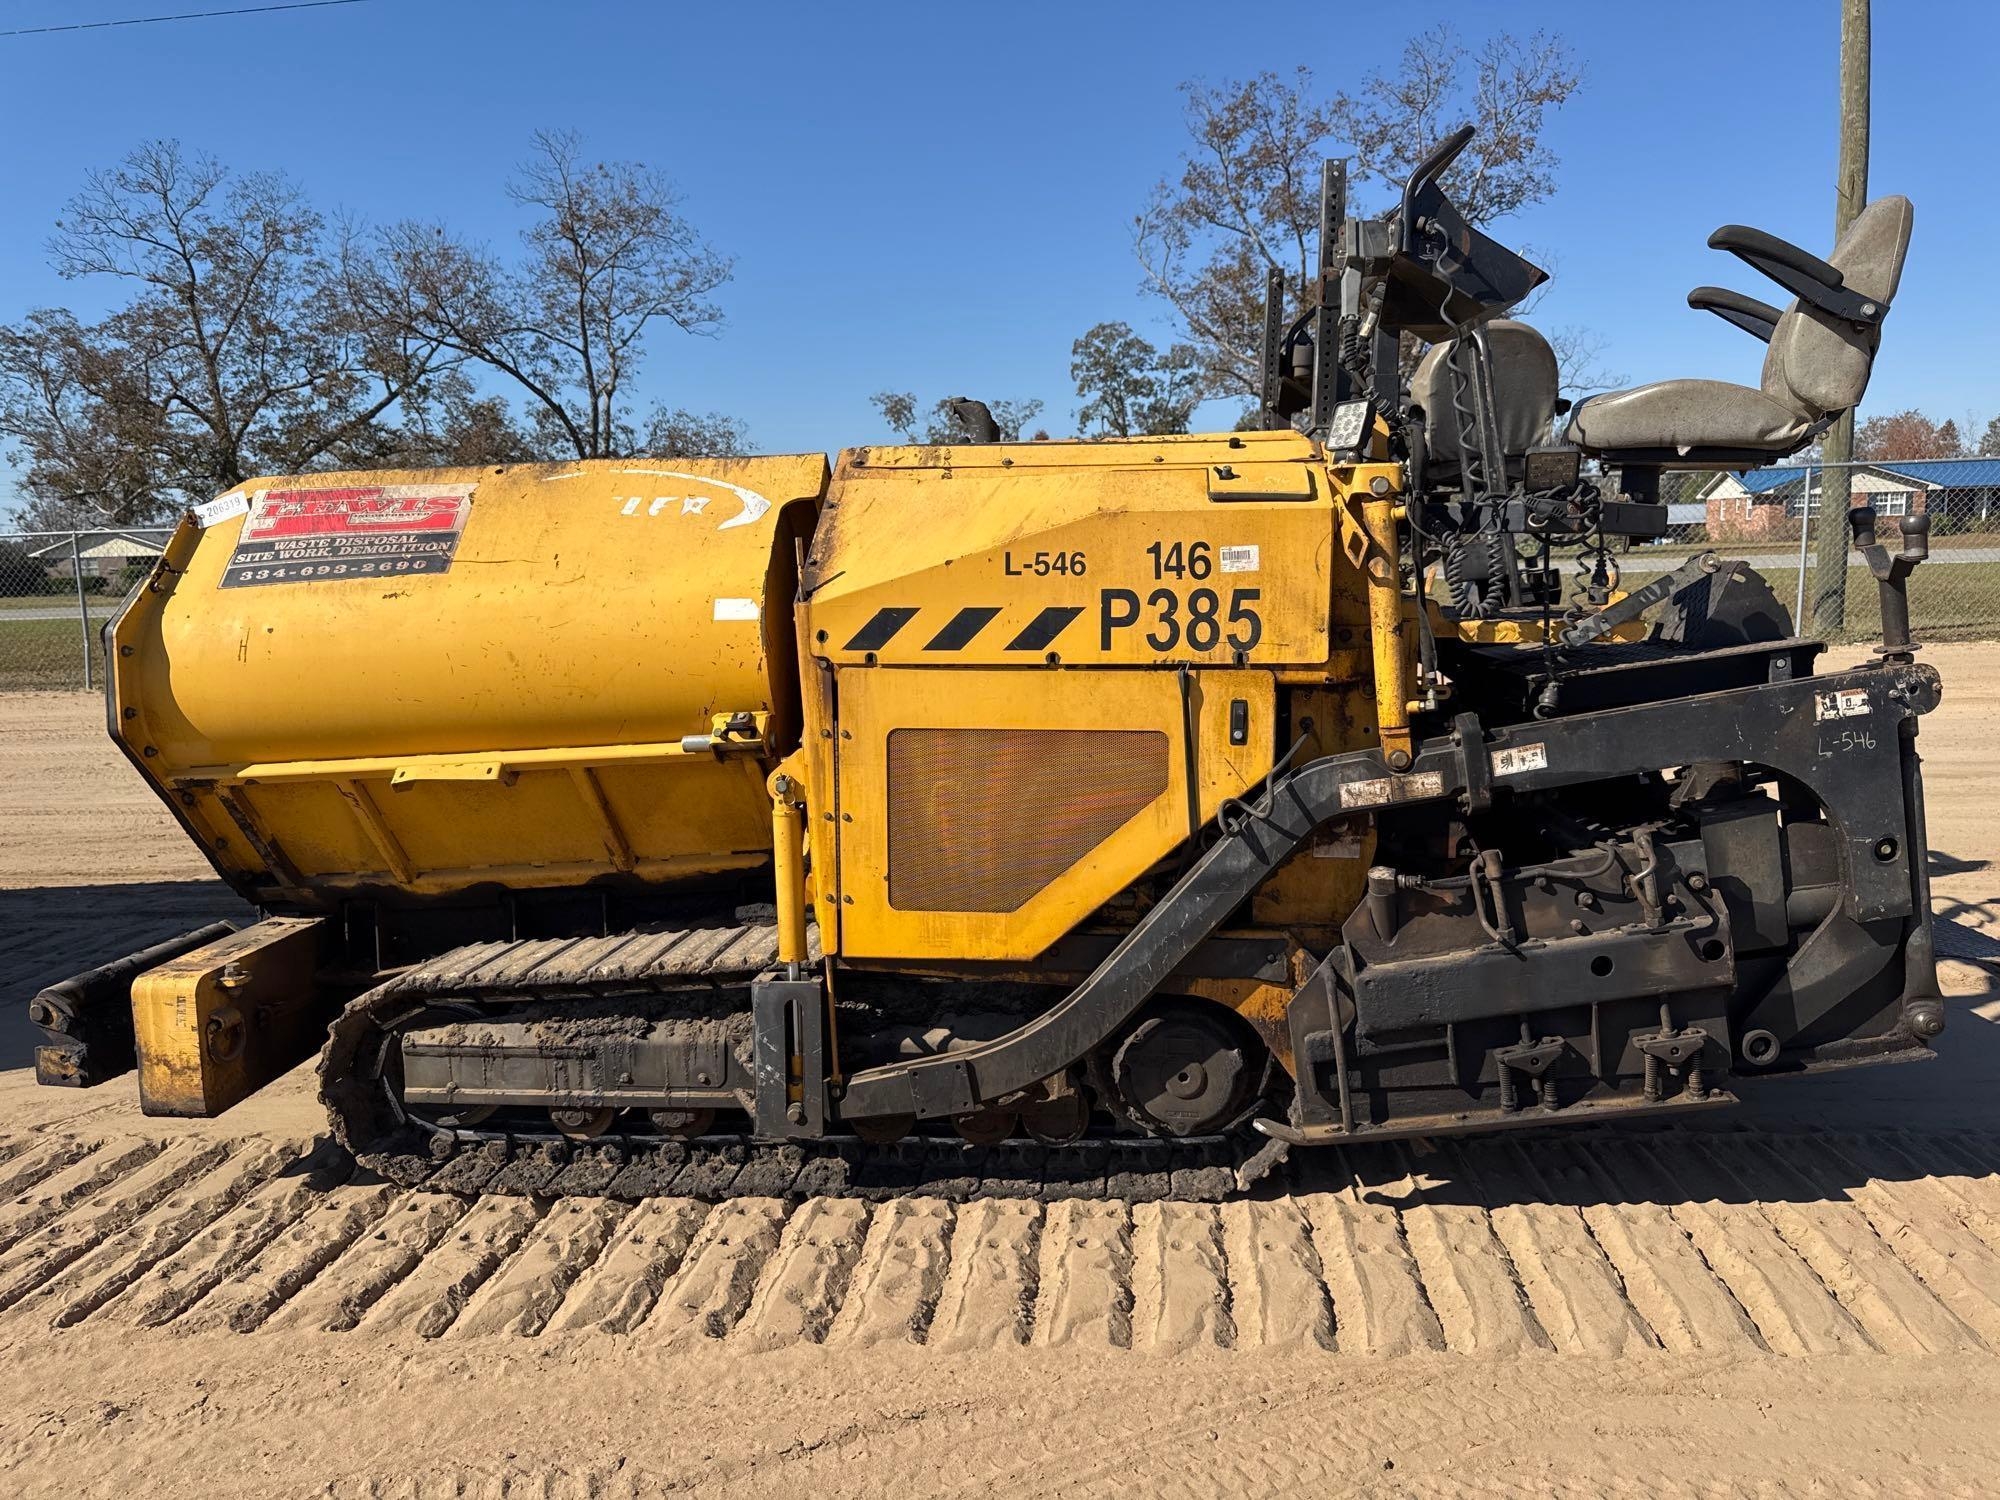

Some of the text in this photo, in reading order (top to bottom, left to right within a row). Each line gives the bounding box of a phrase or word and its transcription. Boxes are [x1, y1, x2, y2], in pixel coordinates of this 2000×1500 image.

[256, 496, 464, 519] LEWIS
[235, 552, 275, 564] SITE
[336, 542, 452, 556] DEMOLITION
[274, 535, 417, 551] WASTE DISPOSAL
[240, 560, 427, 581] 334-693-2690
[1005, 552, 1086, 576] L-546
[1146, 541, 1211, 580] 146
[1100, 588, 1262, 652] P385
[1818, 731, 1876, 757] L-546
